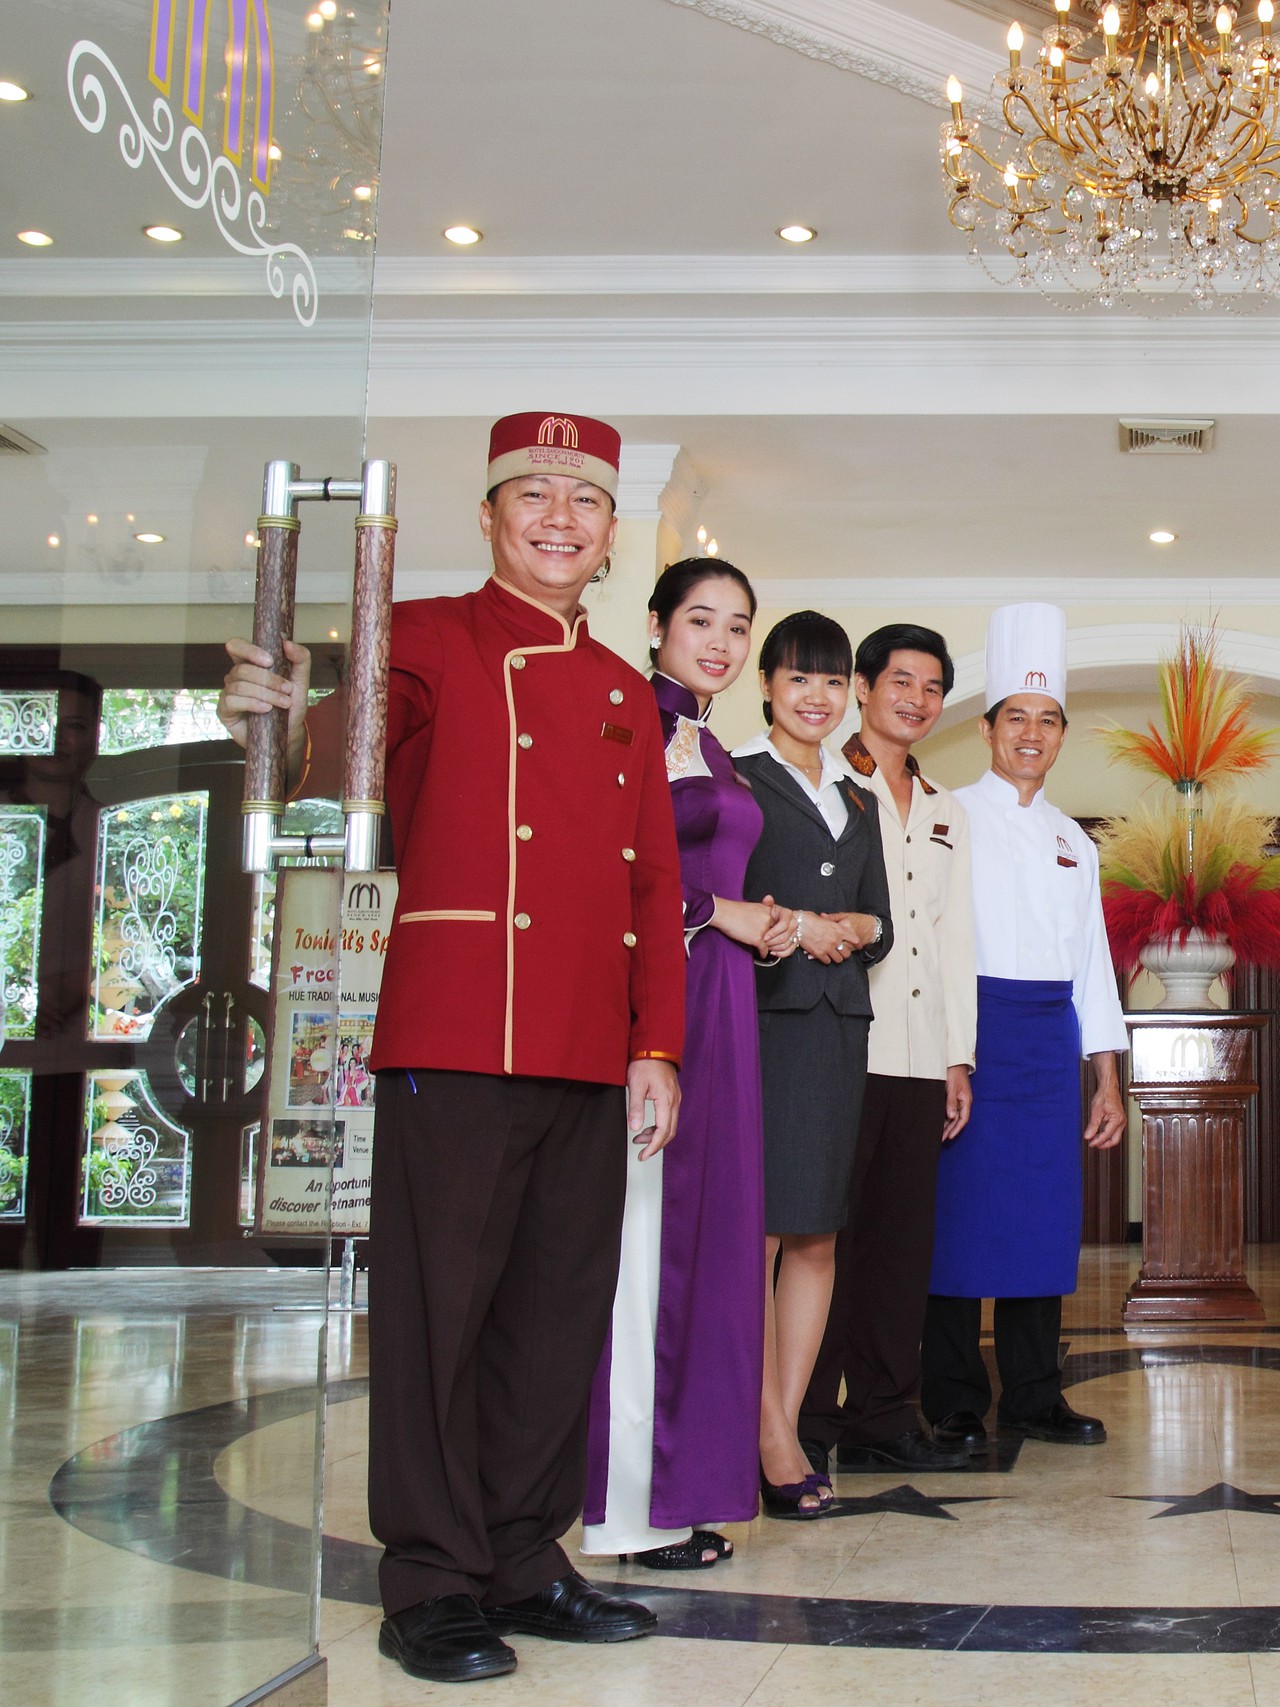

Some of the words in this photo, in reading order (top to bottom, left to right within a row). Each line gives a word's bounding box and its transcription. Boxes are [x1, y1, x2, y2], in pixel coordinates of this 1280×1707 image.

[289, 991, 305, 1001] HUE
[353, 1146, 369, 1154] Venue
[305, 1179, 323, 1192] An
[269, 1197, 320, 1212] discover
